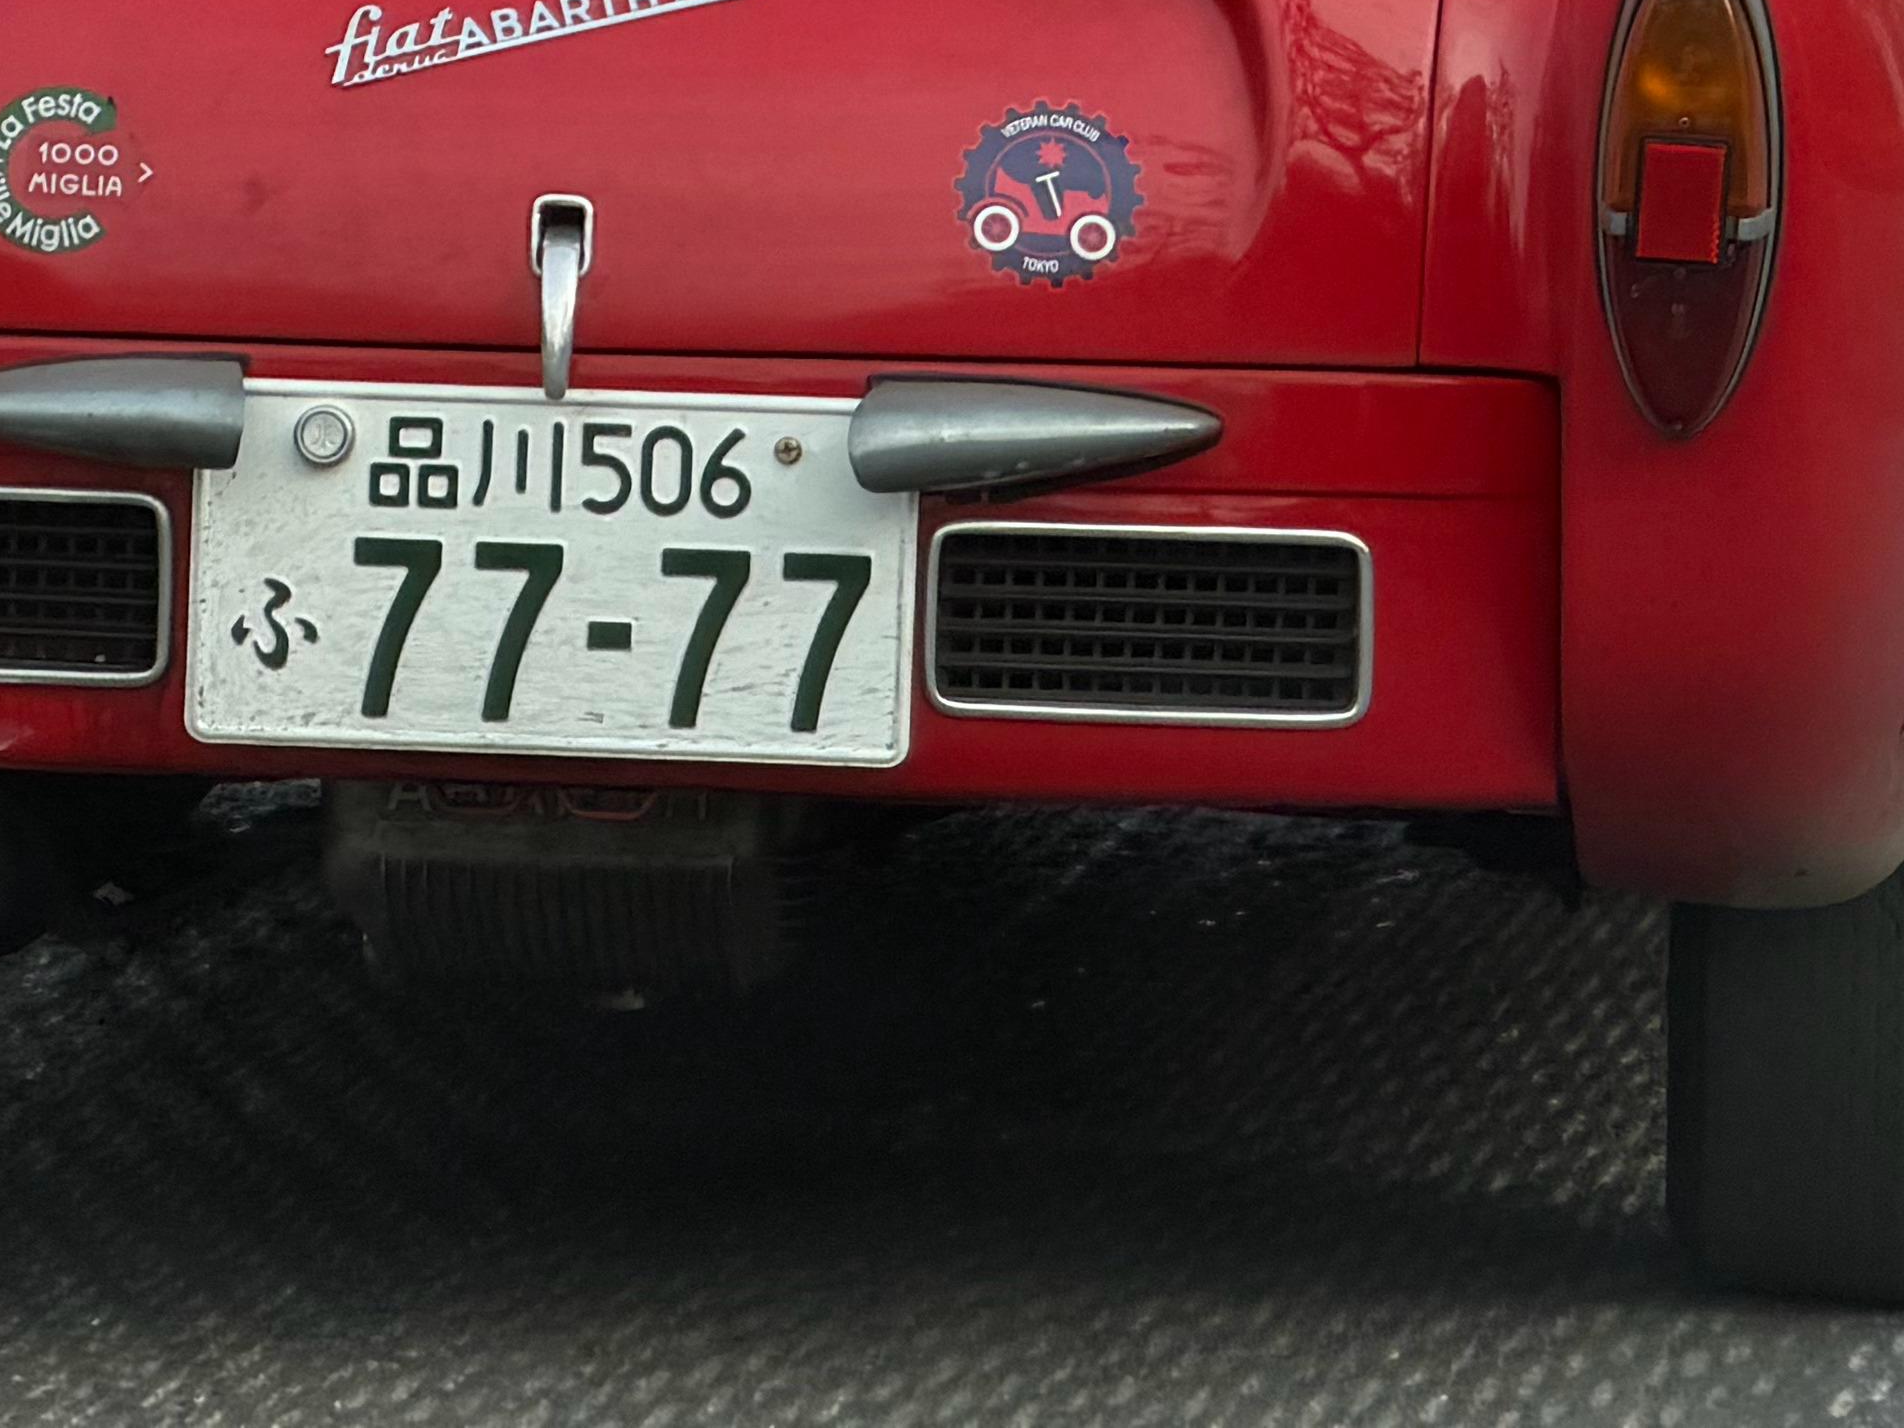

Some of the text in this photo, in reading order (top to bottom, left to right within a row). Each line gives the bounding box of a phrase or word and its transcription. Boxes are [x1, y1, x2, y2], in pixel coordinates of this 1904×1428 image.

[21, 92, 103, 124] Festa
[1050, 114, 1074, 130] CAR
[38, 141, 119, 166] 1000
[28, 172, 123, 197] MIGLIA
[5, 211, 101, 252] Miglia
[1021, 256, 1060, 274] TOKYO
[231, 536, 872, 732] ふ 77-77
